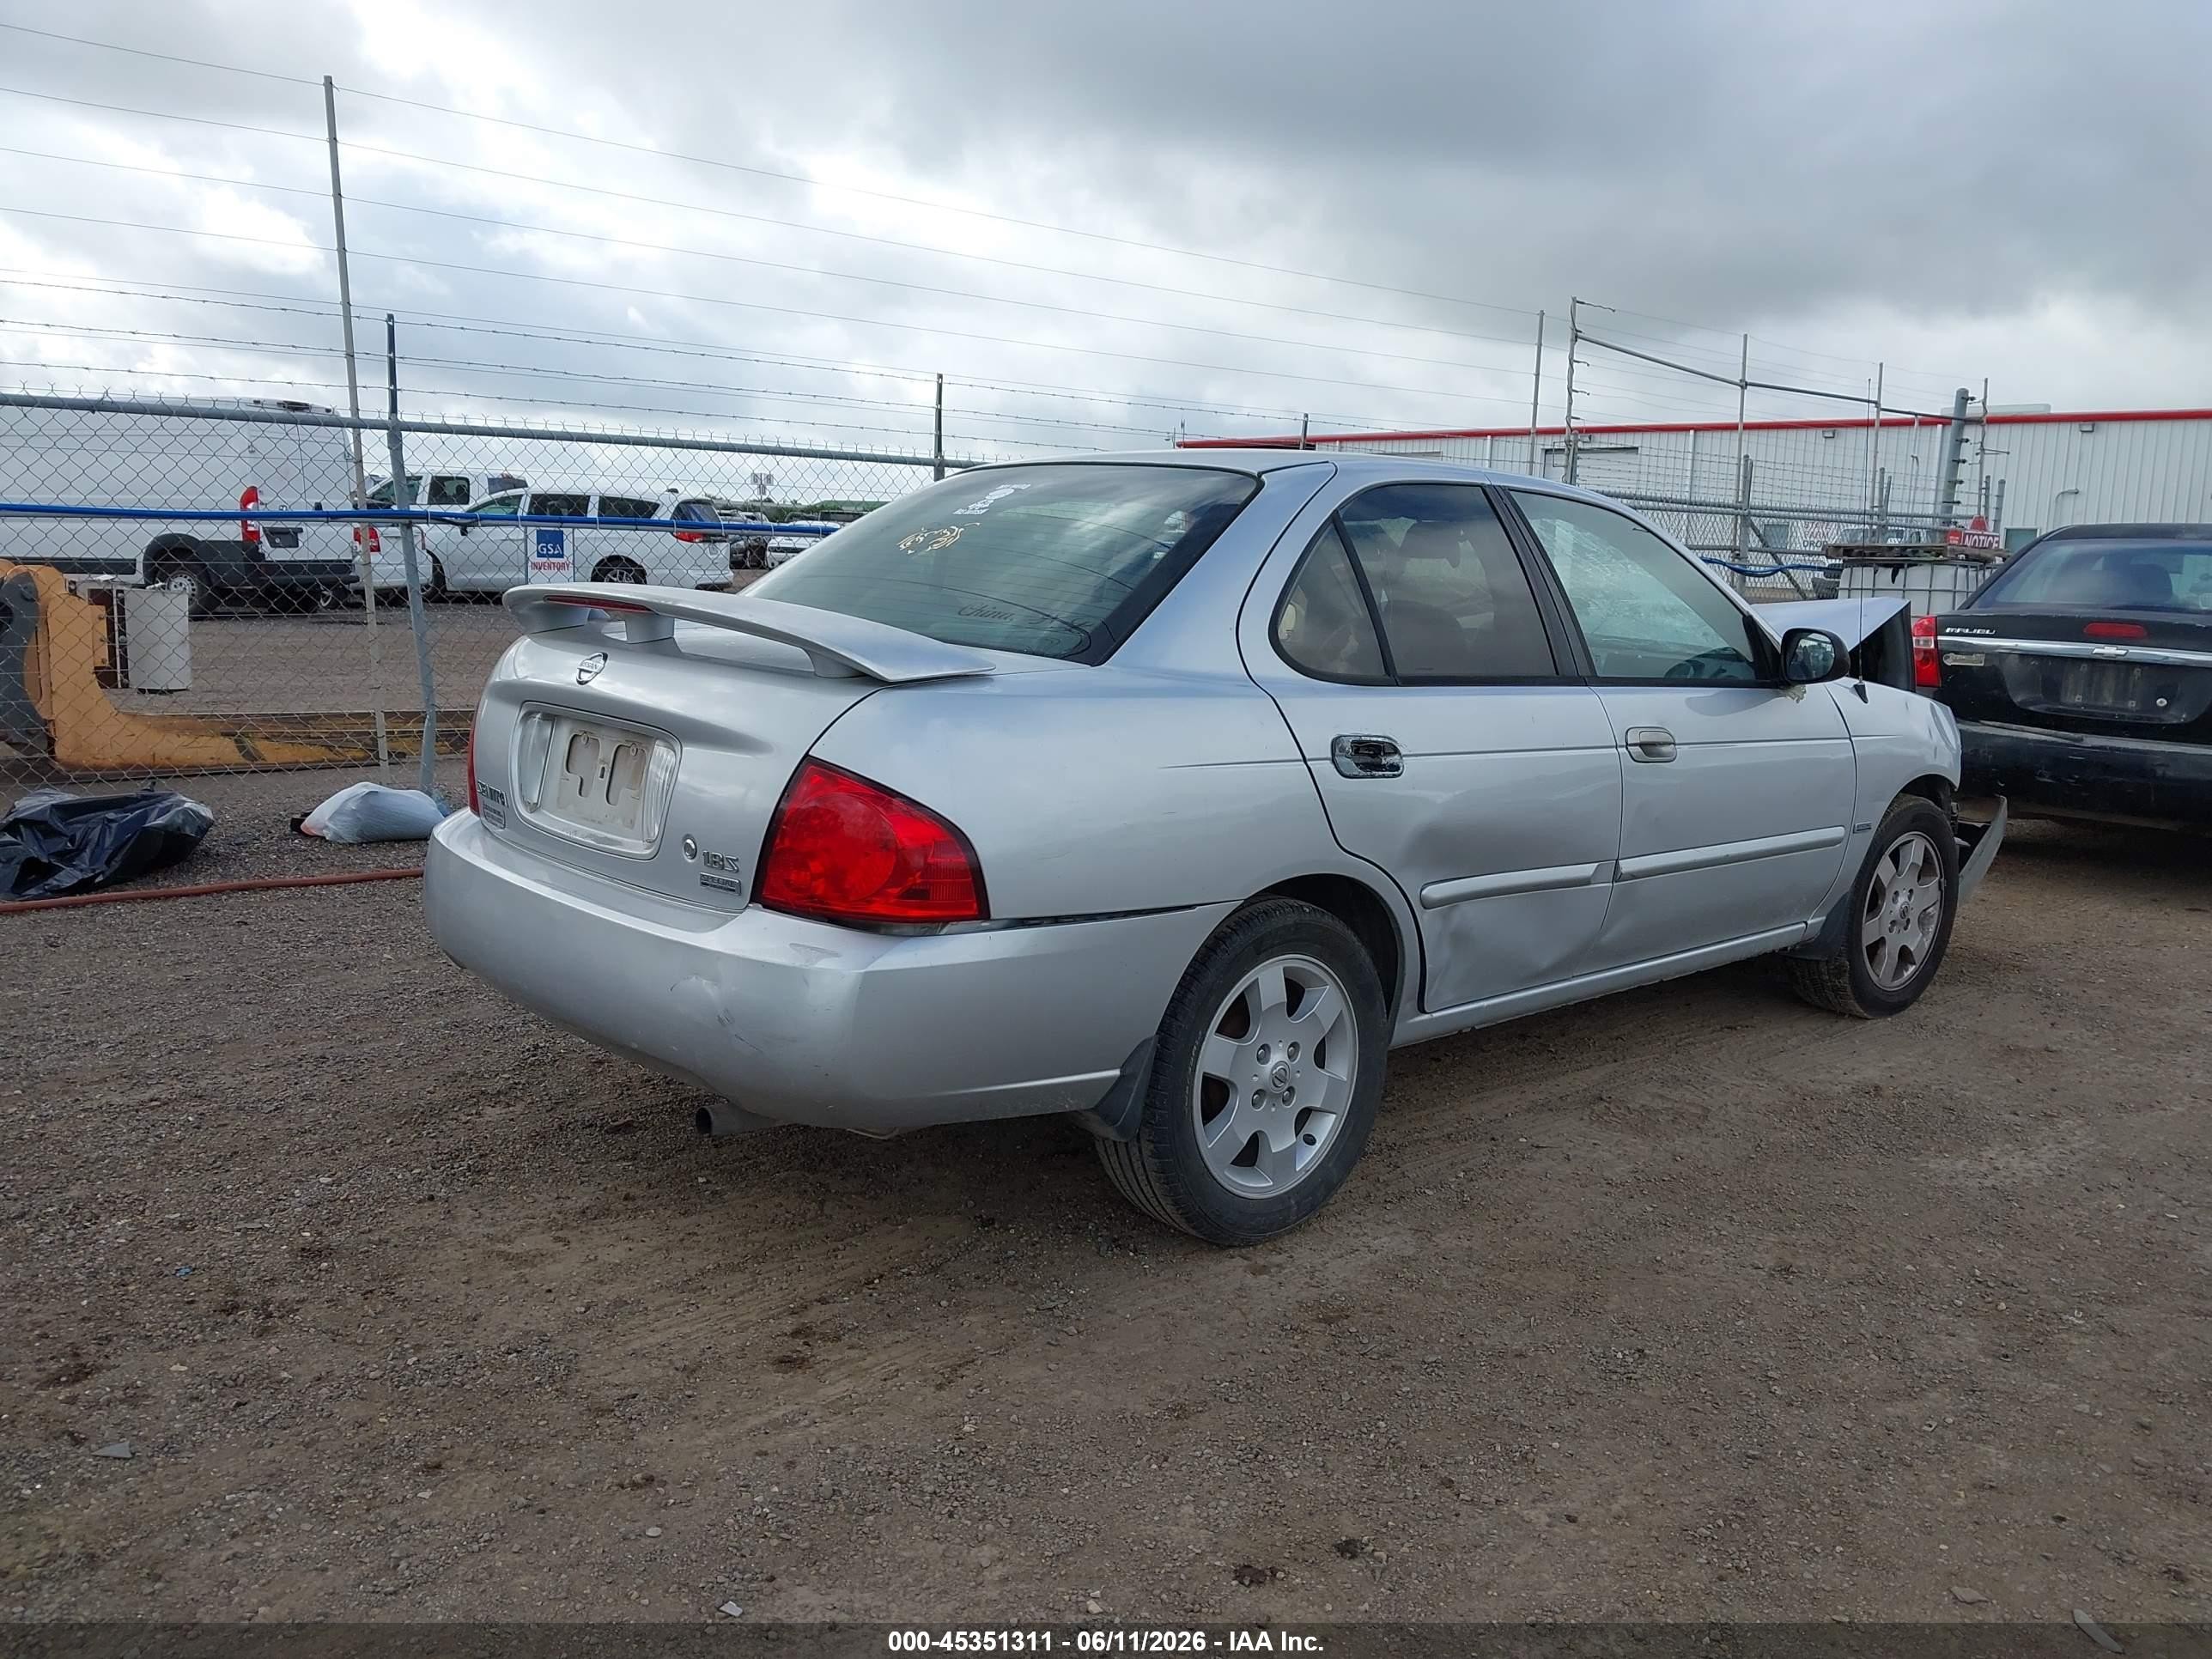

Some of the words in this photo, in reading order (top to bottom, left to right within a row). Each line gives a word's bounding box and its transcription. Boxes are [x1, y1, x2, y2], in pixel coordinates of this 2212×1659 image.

[1964, 534, 2000, 549] NOTICE
[538, 543, 563, 555] GSA
[531, 561, 571, 572] INVENTORY
[477, 779, 509, 808] SENTRA
